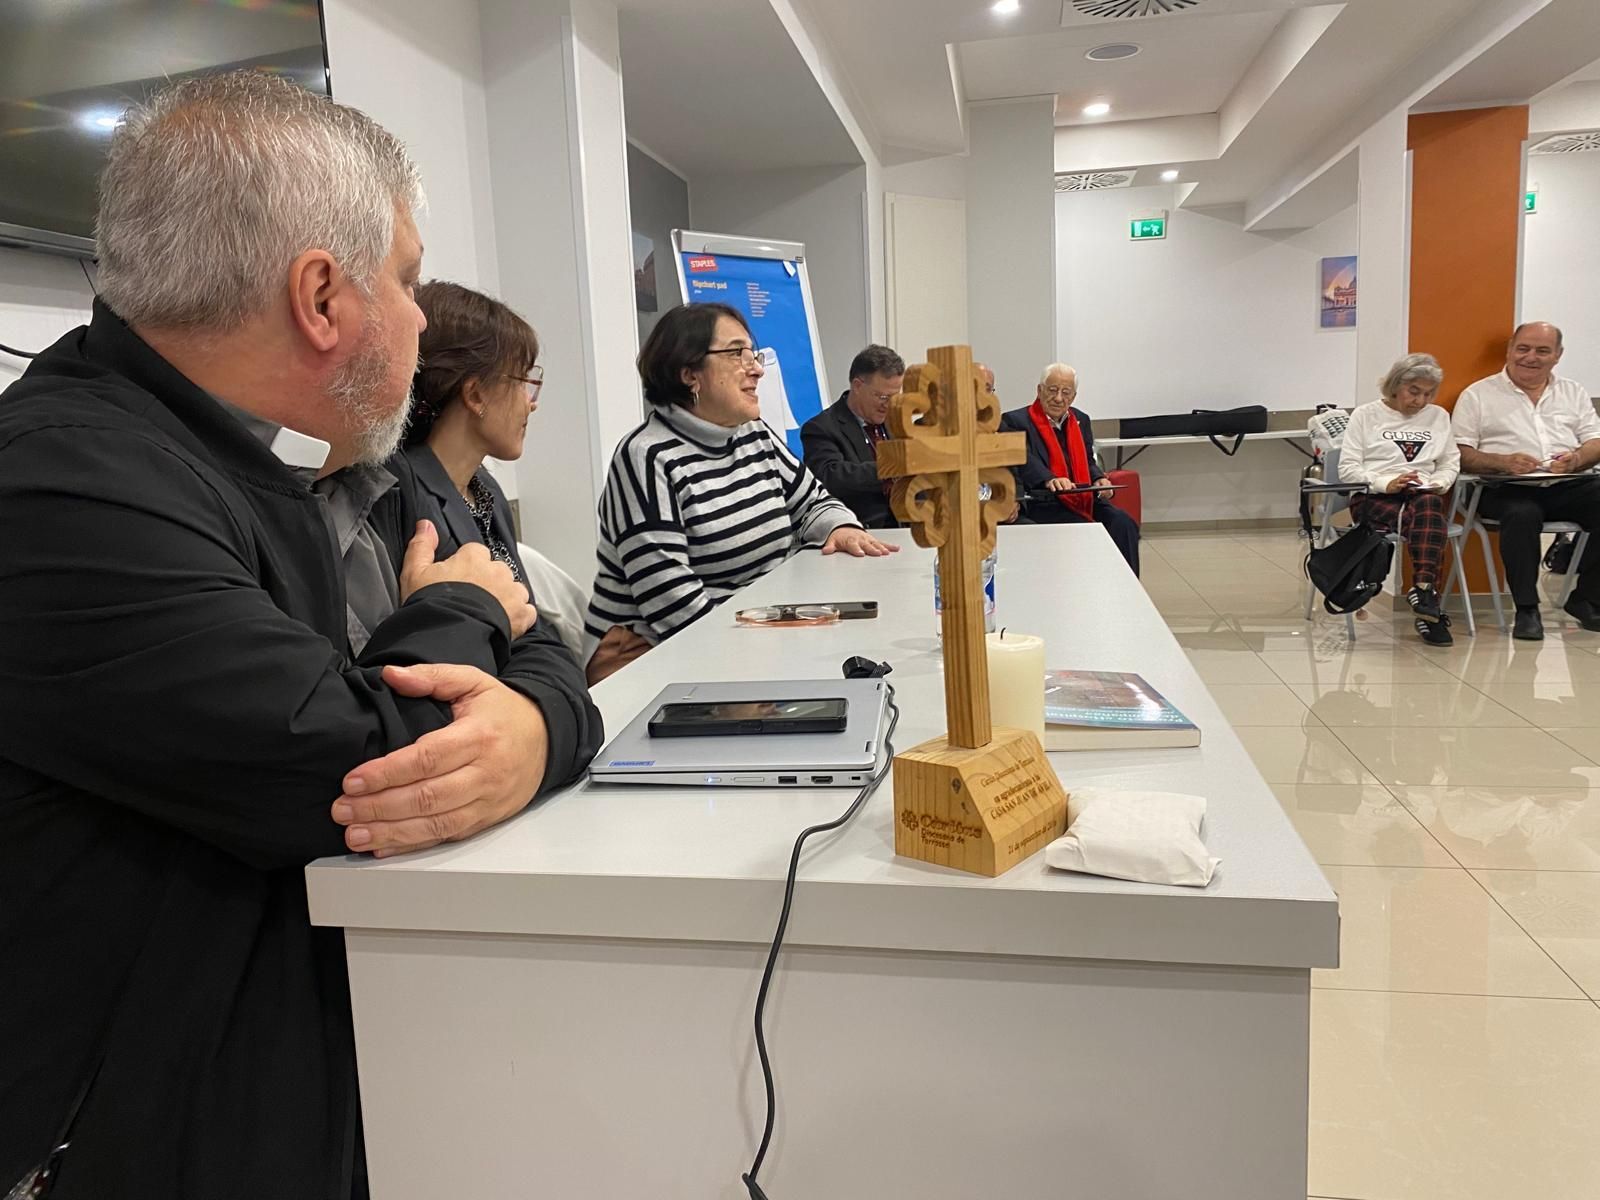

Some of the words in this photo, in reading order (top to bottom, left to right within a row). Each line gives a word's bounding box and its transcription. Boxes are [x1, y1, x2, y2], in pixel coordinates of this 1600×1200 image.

[690, 260, 716, 269] STAPLES
[717, 282, 727, 290] pad
[1382, 430, 1432, 441] GUESS
[956, 836, 965, 844] de
